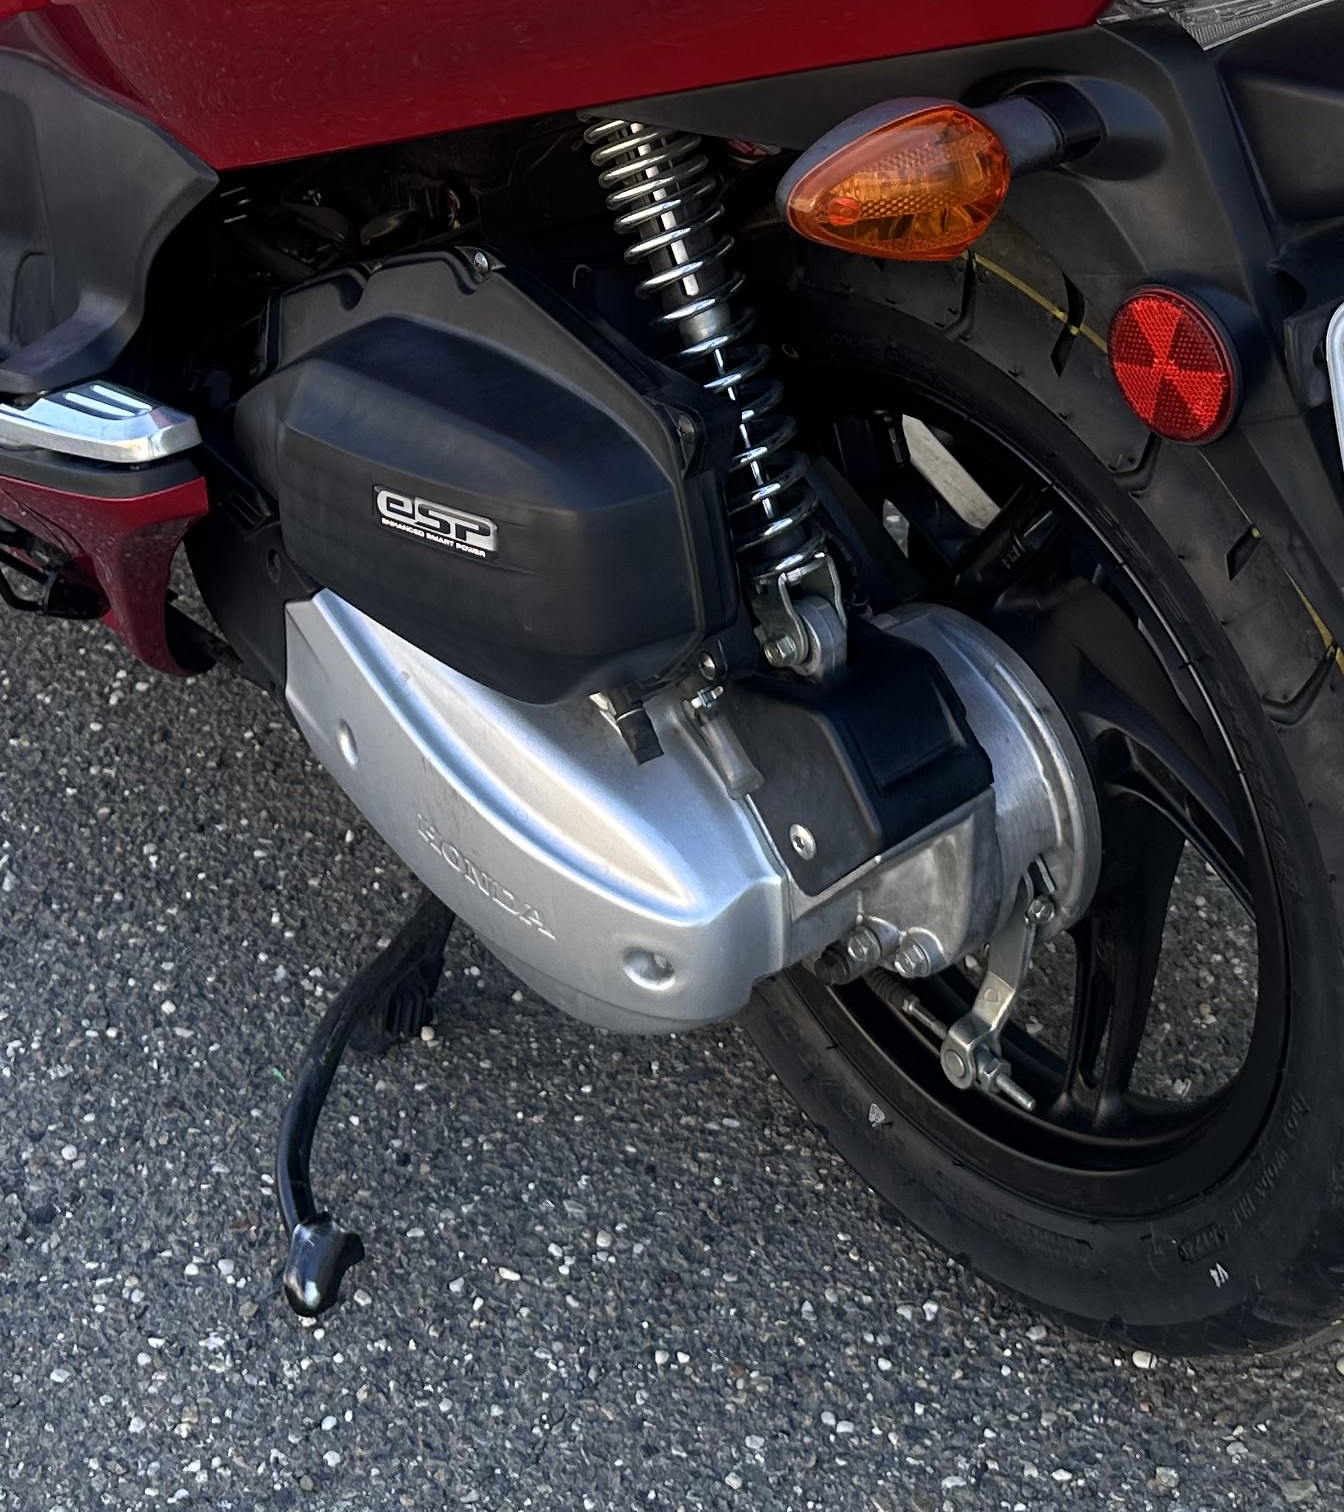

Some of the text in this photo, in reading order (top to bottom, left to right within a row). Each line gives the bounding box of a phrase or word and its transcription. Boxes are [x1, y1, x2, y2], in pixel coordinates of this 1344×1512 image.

[381, 517, 487, 558] ENHANCED SMART POWER
[416, 812, 556, 941] HONDA
